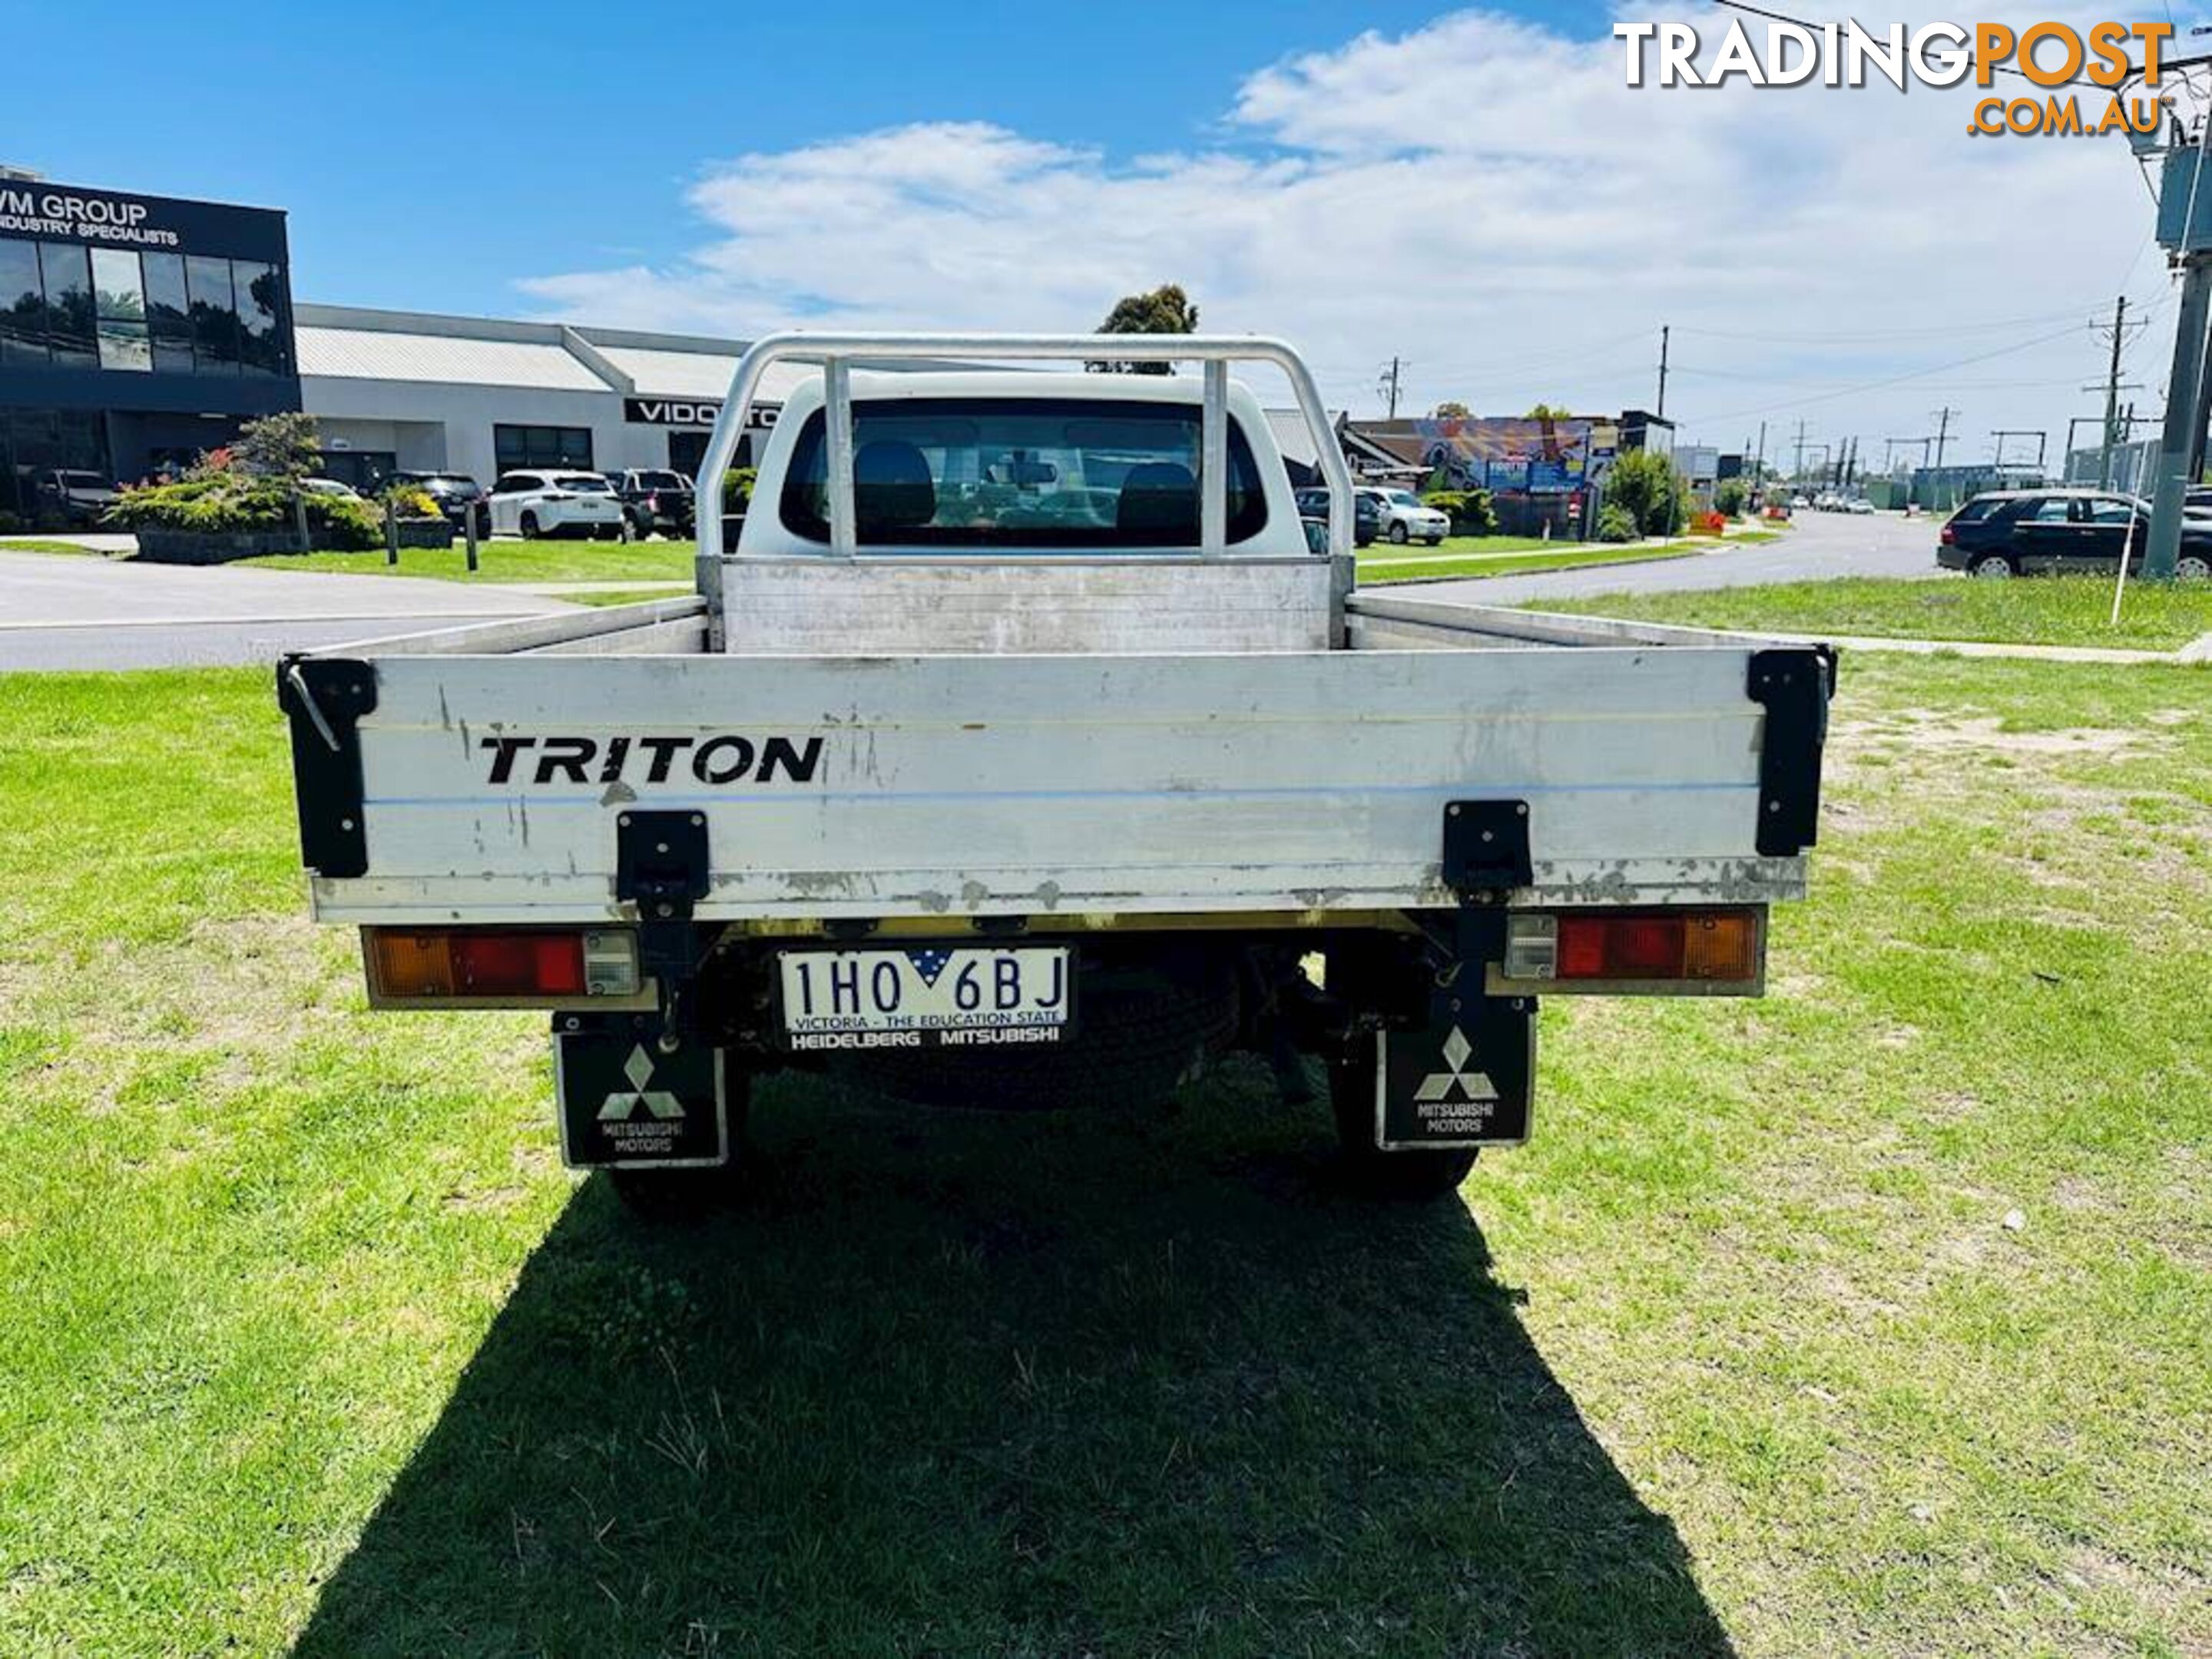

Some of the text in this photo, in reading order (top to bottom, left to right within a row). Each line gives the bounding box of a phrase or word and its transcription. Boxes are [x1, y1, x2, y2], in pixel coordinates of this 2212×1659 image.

[41, 194, 147, 227] GROUP
[78, 222, 178, 246] SPECIALISTS
[638, 402, 779, 426] VIDOTO
[481, 736, 824, 784] TRITON
[955, 956, 1062, 1012] 6BJ
[795, 1017, 868, 1030] VICTORIA
[886, 1015, 915, 1028] THE
[920, 1013, 1012, 1027] EDUCATION
[1017, 1011, 1060, 1024] STATE
[791, 1027, 1060, 1050] HEIDELBERG MITSUBISHI
[1417, 1103, 1494, 1118] MITSUBISHI
[601, 1121, 683, 1137] MITSUBISHI
[1427, 1118, 1482, 1133] MOTORS
[614, 1138, 672, 1152] MOTORS
